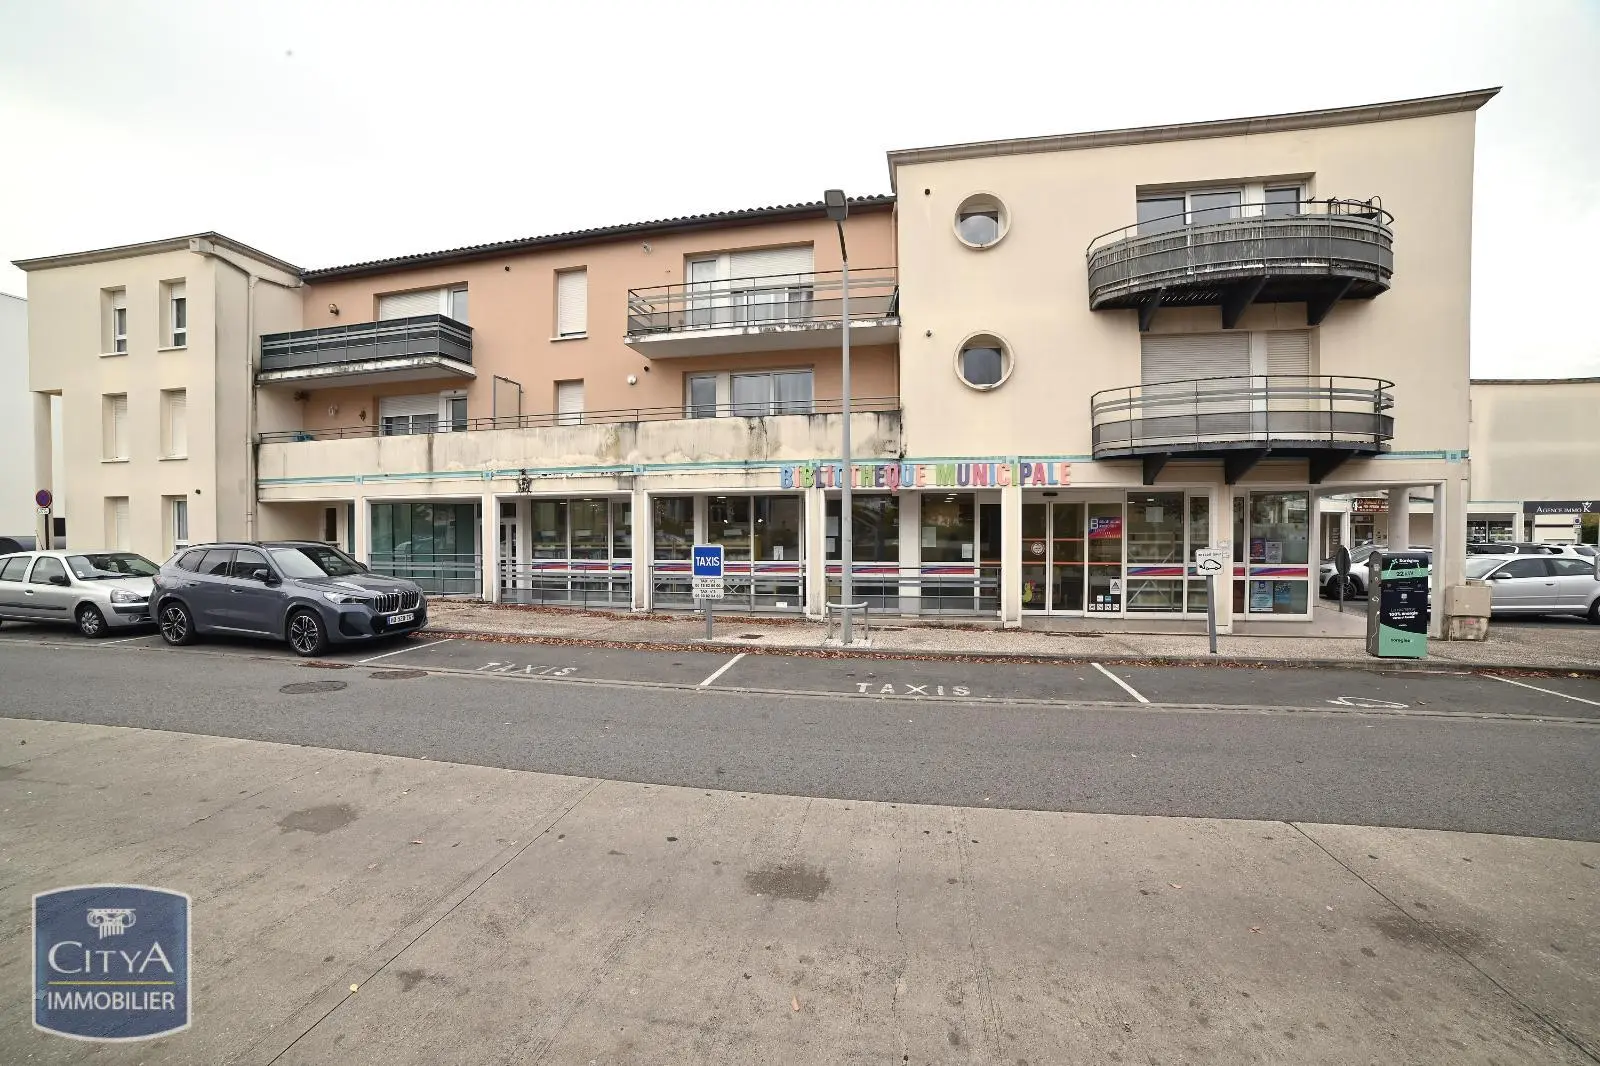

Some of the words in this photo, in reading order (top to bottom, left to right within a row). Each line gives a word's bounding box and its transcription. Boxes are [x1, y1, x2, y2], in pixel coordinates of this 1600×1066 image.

[780, 463, 927, 491] BIBLIOTHEQUE
[936, 462, 1072, 487] MUNICIPALE
[695, 556, 720, 566] TAXIS
[855, 682, 971, 696] TAXIS
